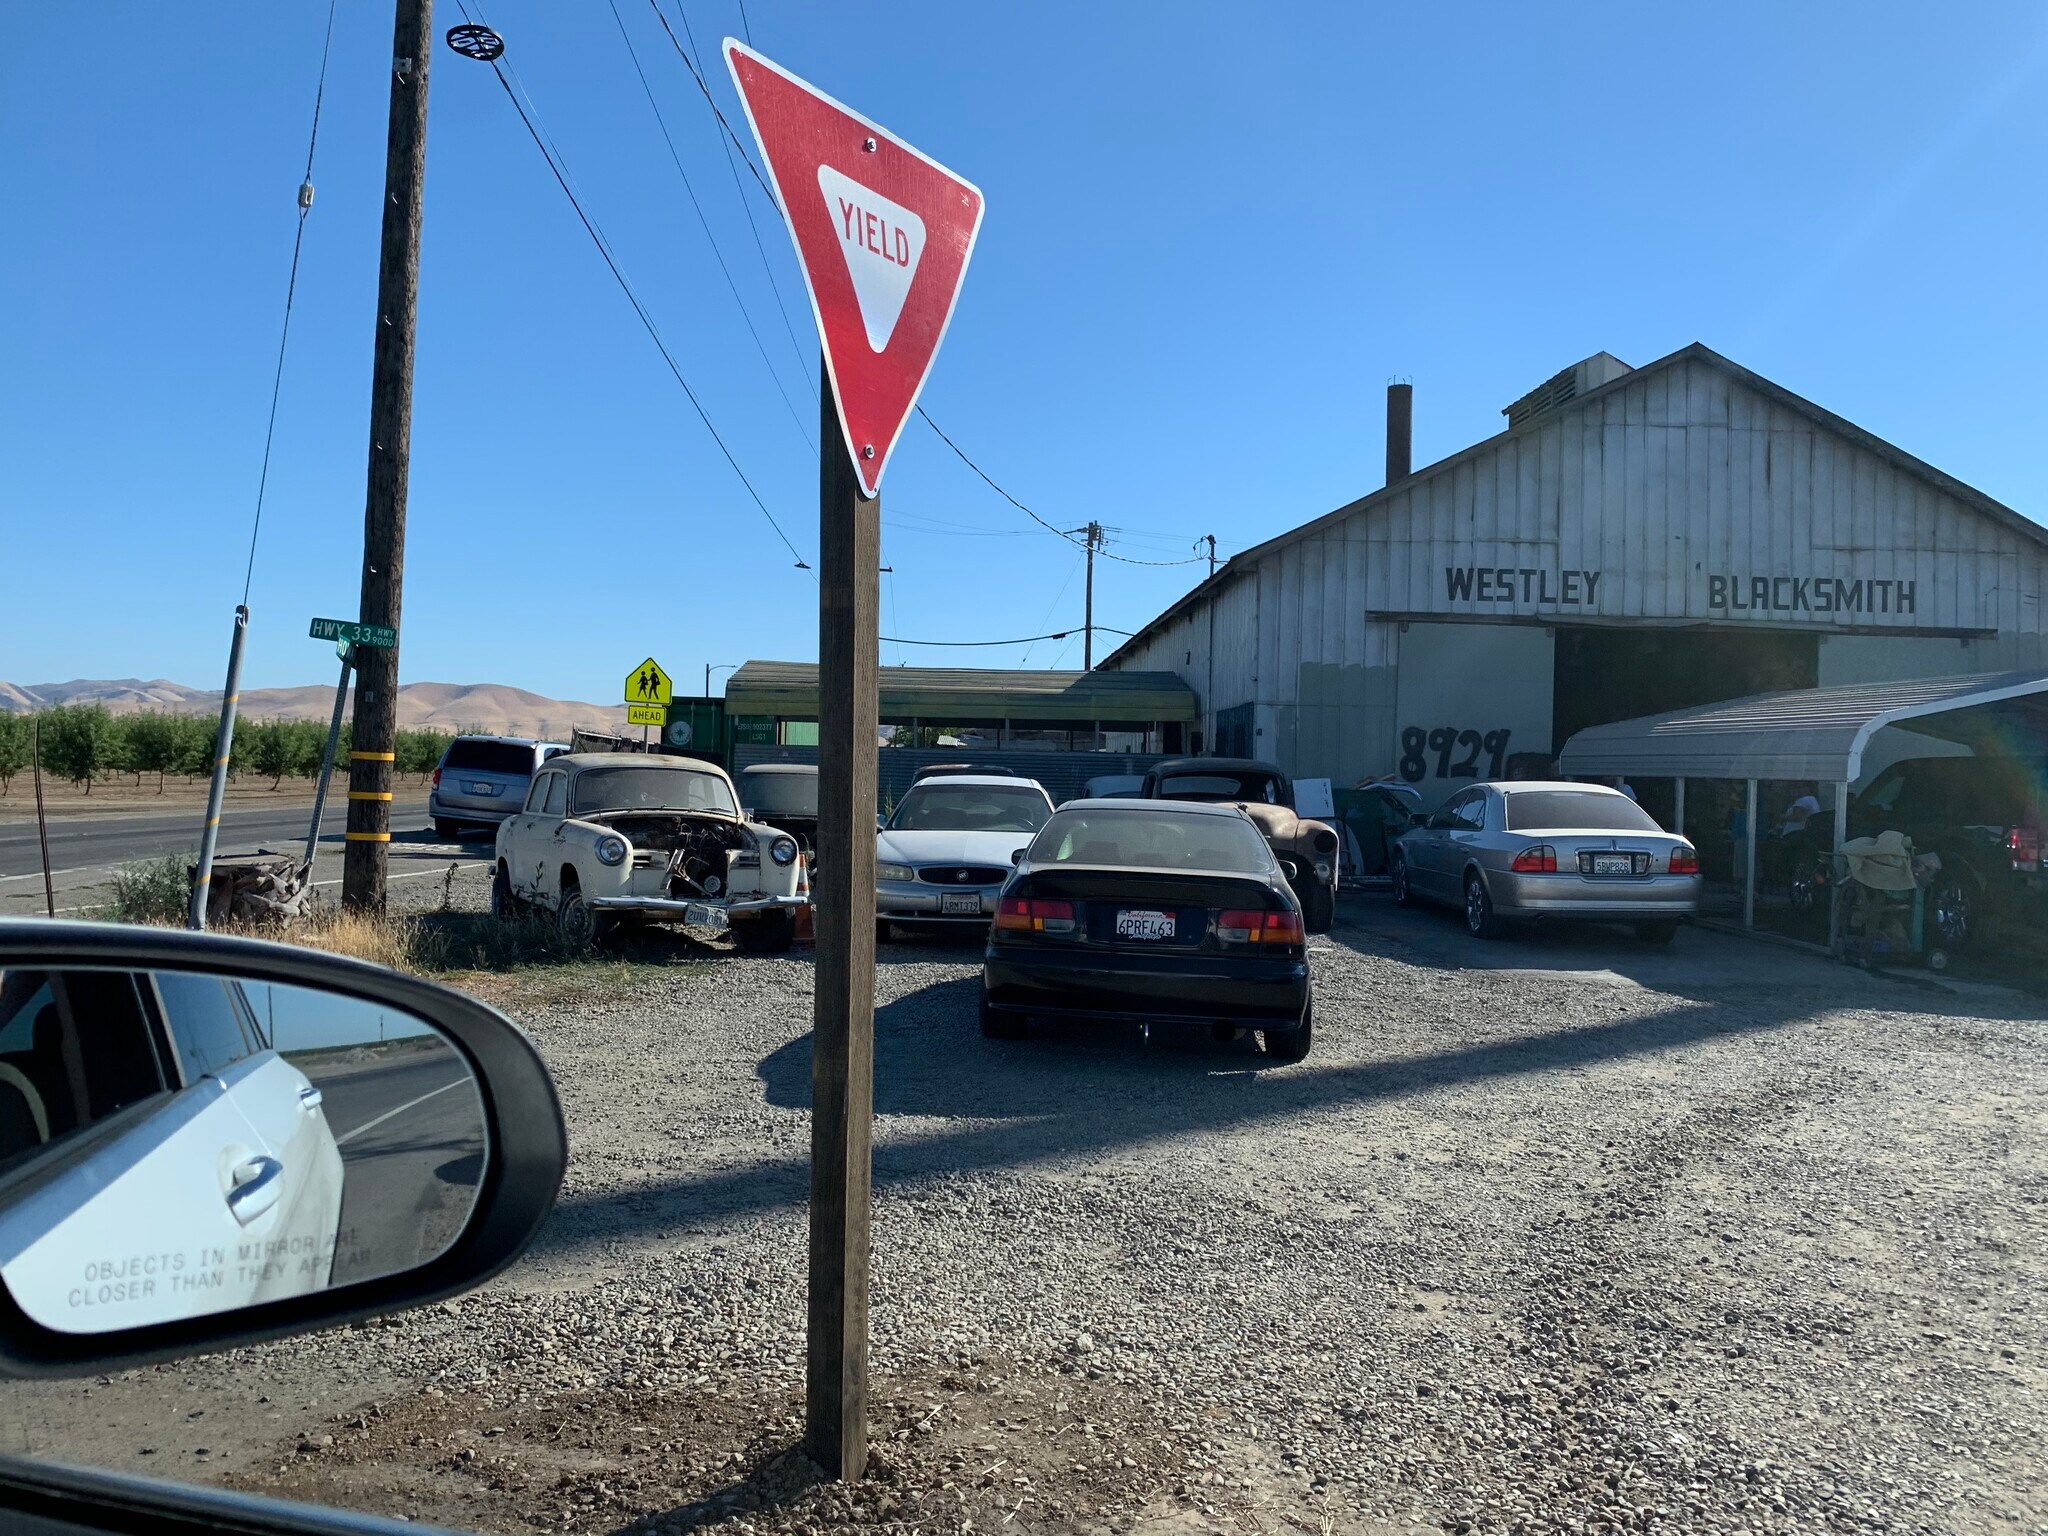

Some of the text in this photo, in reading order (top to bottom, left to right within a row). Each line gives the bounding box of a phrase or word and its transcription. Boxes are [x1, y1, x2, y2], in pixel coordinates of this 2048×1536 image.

[838, 196, 909, 267] YIELD
[1445, 567, 1915, 613] WESTLEY BLACKSMITH
[313, 621, 371, 642] HWY 33
[372, 636, 394, 647] 9000
[377, 628, 395, 638] HWY
[632, 710, 661, 721] AHEAD
[1400, 726, 1512, 782] 8929
[85, 1252, 186, 1282] OBJECTS
[201, 1248, 225, 1267] IN
[238, 1236, 315, 1261] MIRROR
[69, 1279, 156, 1308] CLOSER
[171, 1271, 225, 1292] THAN
[238, 1262, 287, 1283] THEY
